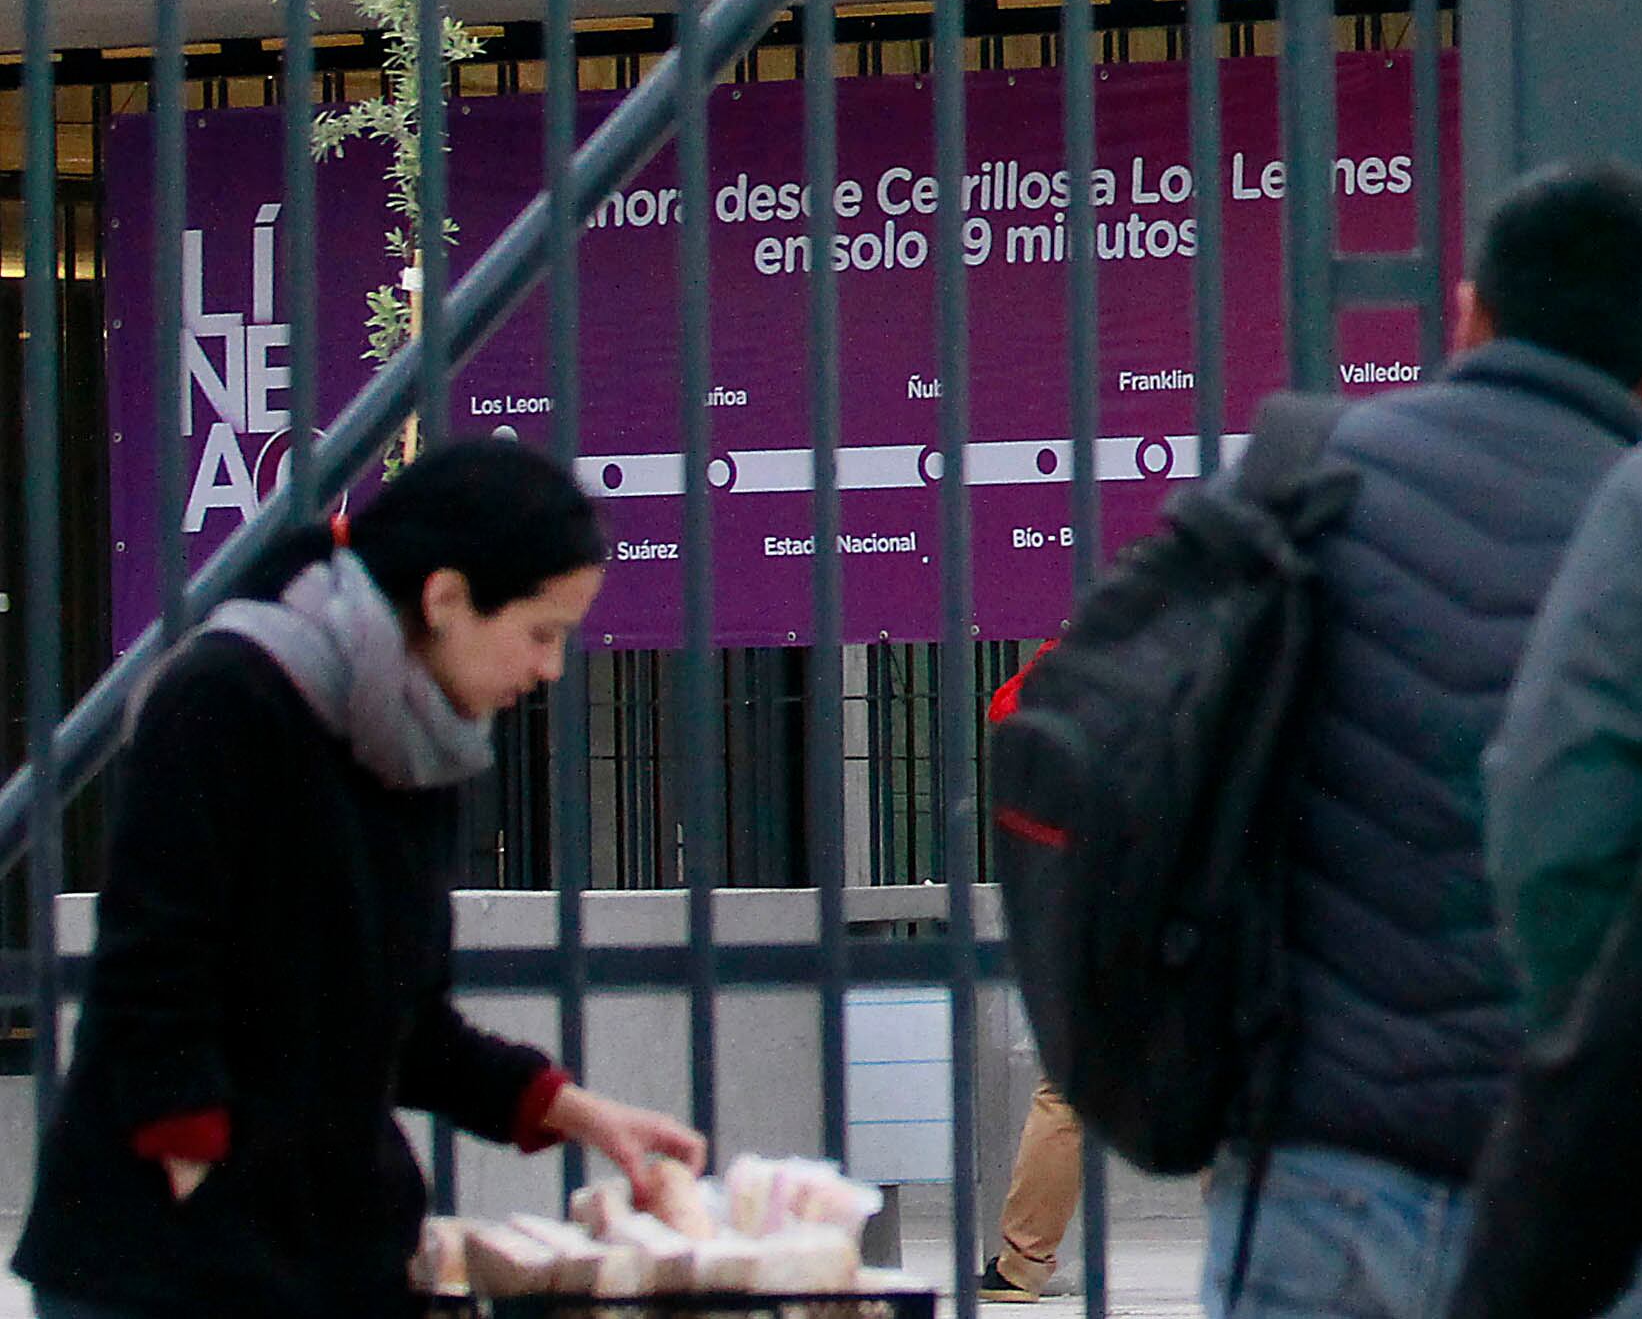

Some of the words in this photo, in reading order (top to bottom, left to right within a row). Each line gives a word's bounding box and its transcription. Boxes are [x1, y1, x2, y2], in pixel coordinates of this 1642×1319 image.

[587, 189, 684, 228] hor
[876, 160, 1072, 215] Cerillos
[1089, 168, 1116, 205] a
[1132, 156, 1197, 203] Lo
[1231, 151, 1413, 200] Lenes
[754, 234, 813, 275] en
[831, 220, 929, 272] solo
[961, 217, 993, 266] 9
[1005, 211, 1198, 264] miutos
[1118, 369, 1195, 391] Franklin
[1340, 361, 1421, 384] Valledor
[704, 386, 748, 407] uñoa
[907, 374, 943, 399] Ñub
[470, 396, 502, 416] Los
[505, 394, 554, 414] Leon
[763, 534, 816, 556] Estad
[836, 531, 917, 553] Nacional
[1011, 526, 1044, 548] Bío
[617, 539, 680, 560] Suárez
